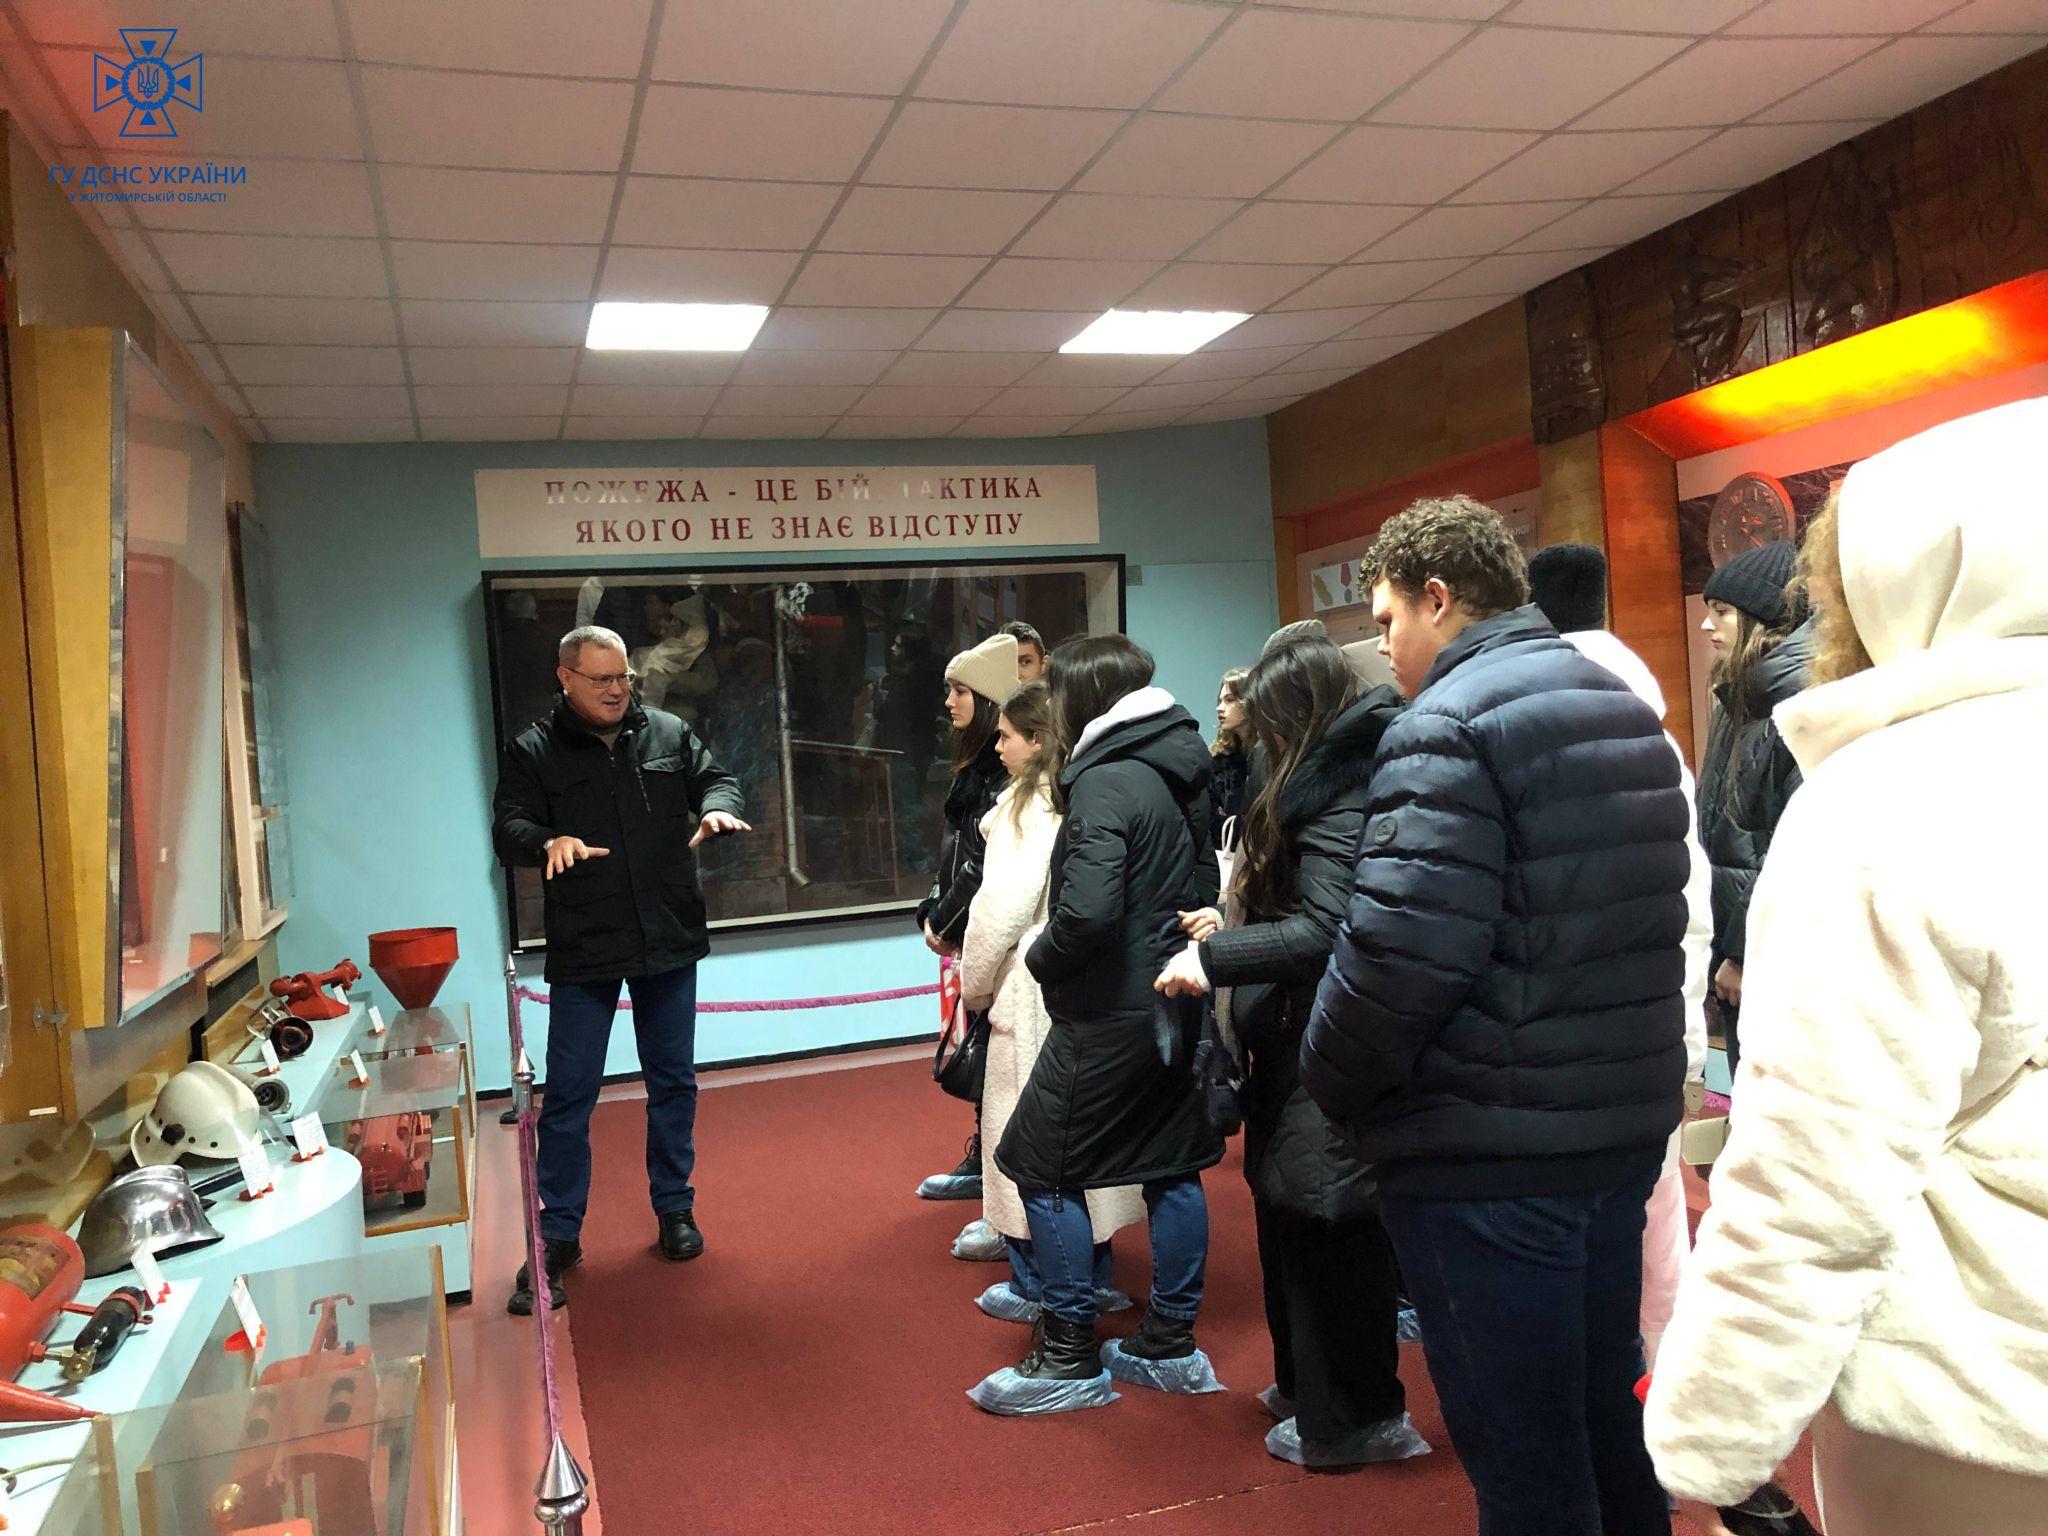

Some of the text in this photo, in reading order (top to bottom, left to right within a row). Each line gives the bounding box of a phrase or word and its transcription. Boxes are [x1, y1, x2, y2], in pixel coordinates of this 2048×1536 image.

[545, 480, 710, 505] ПОЖЕЖА
[755, 476, 798, 505] ЦЕ
[576, 511, 1024, 543] ЯКОГО НЕ ЗНАЄ ВІДСТУПУ
